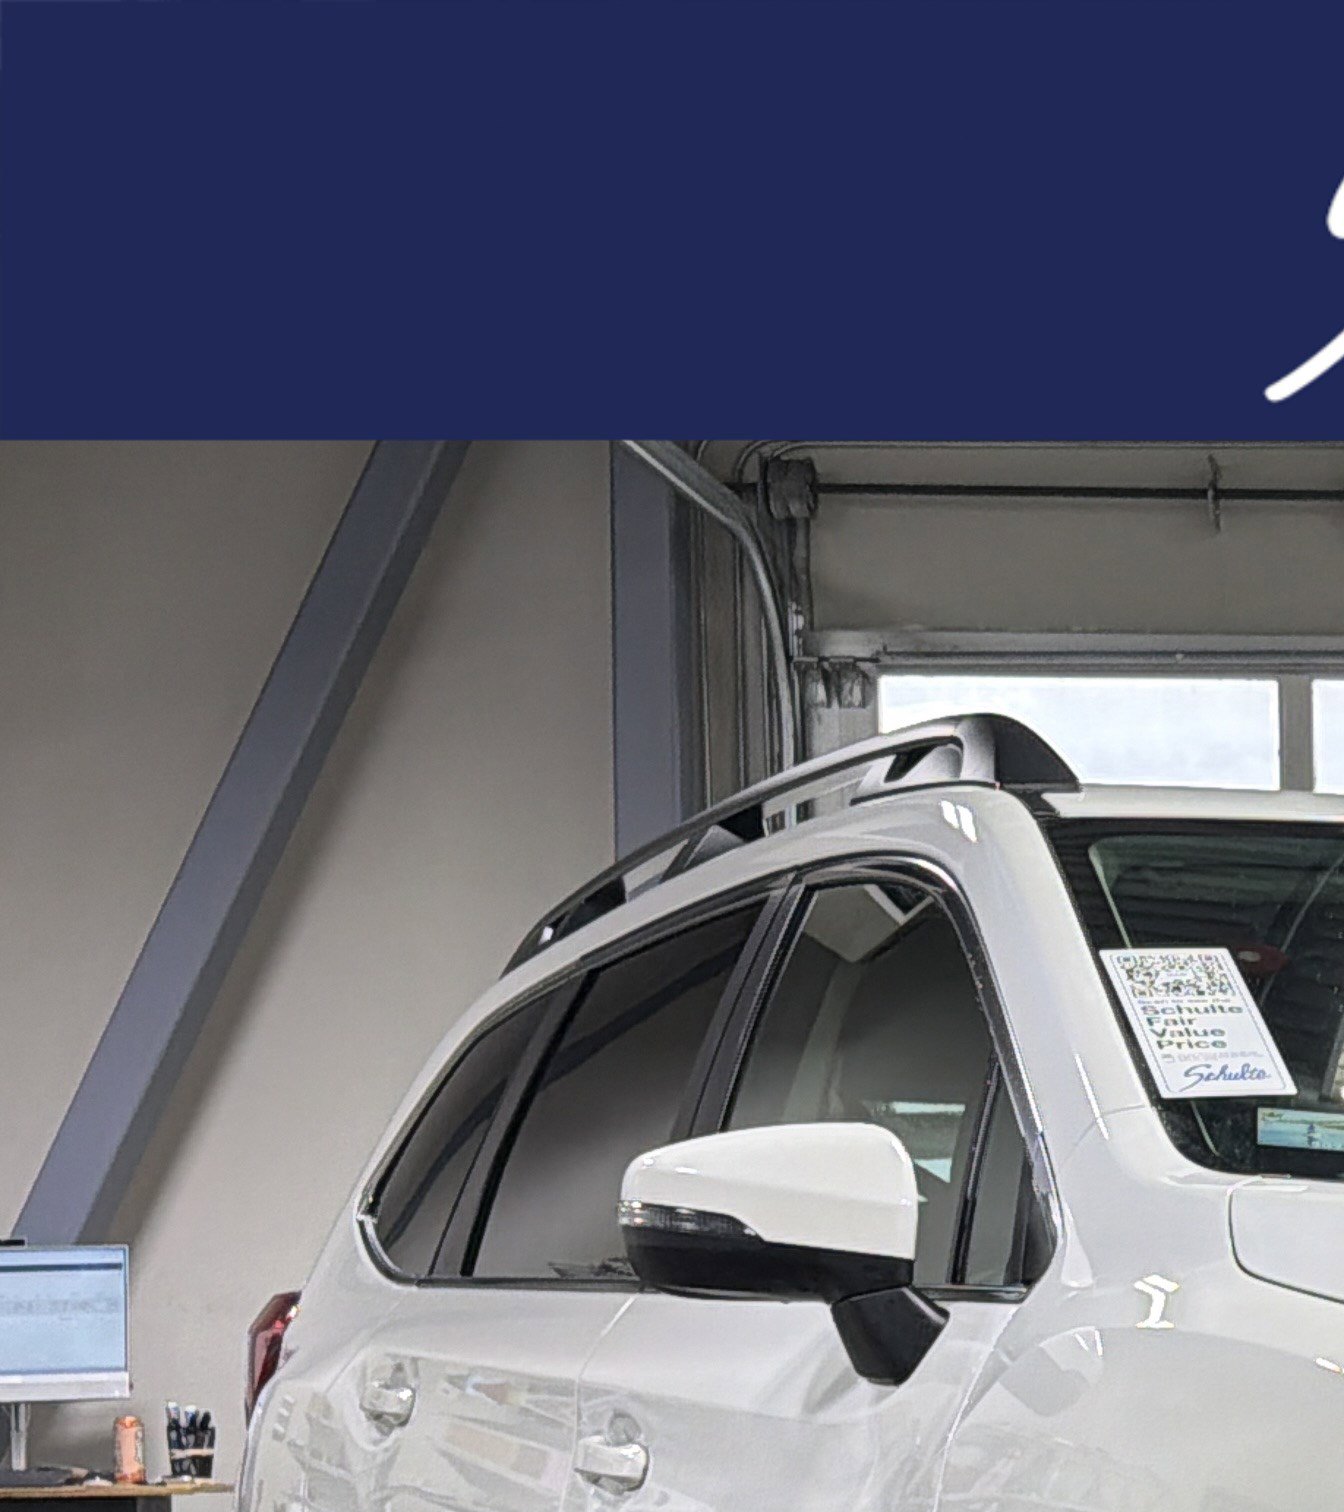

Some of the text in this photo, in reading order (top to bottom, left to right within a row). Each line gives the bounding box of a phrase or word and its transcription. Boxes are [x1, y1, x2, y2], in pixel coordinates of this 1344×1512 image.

[1140, 1004, 1244, 1016] Schulte
[1146, 1016, 1197, 1027] Fair
[1149, 1027, 1226, 1038] Value
[1156, 1038, 1228, 1050] Price
